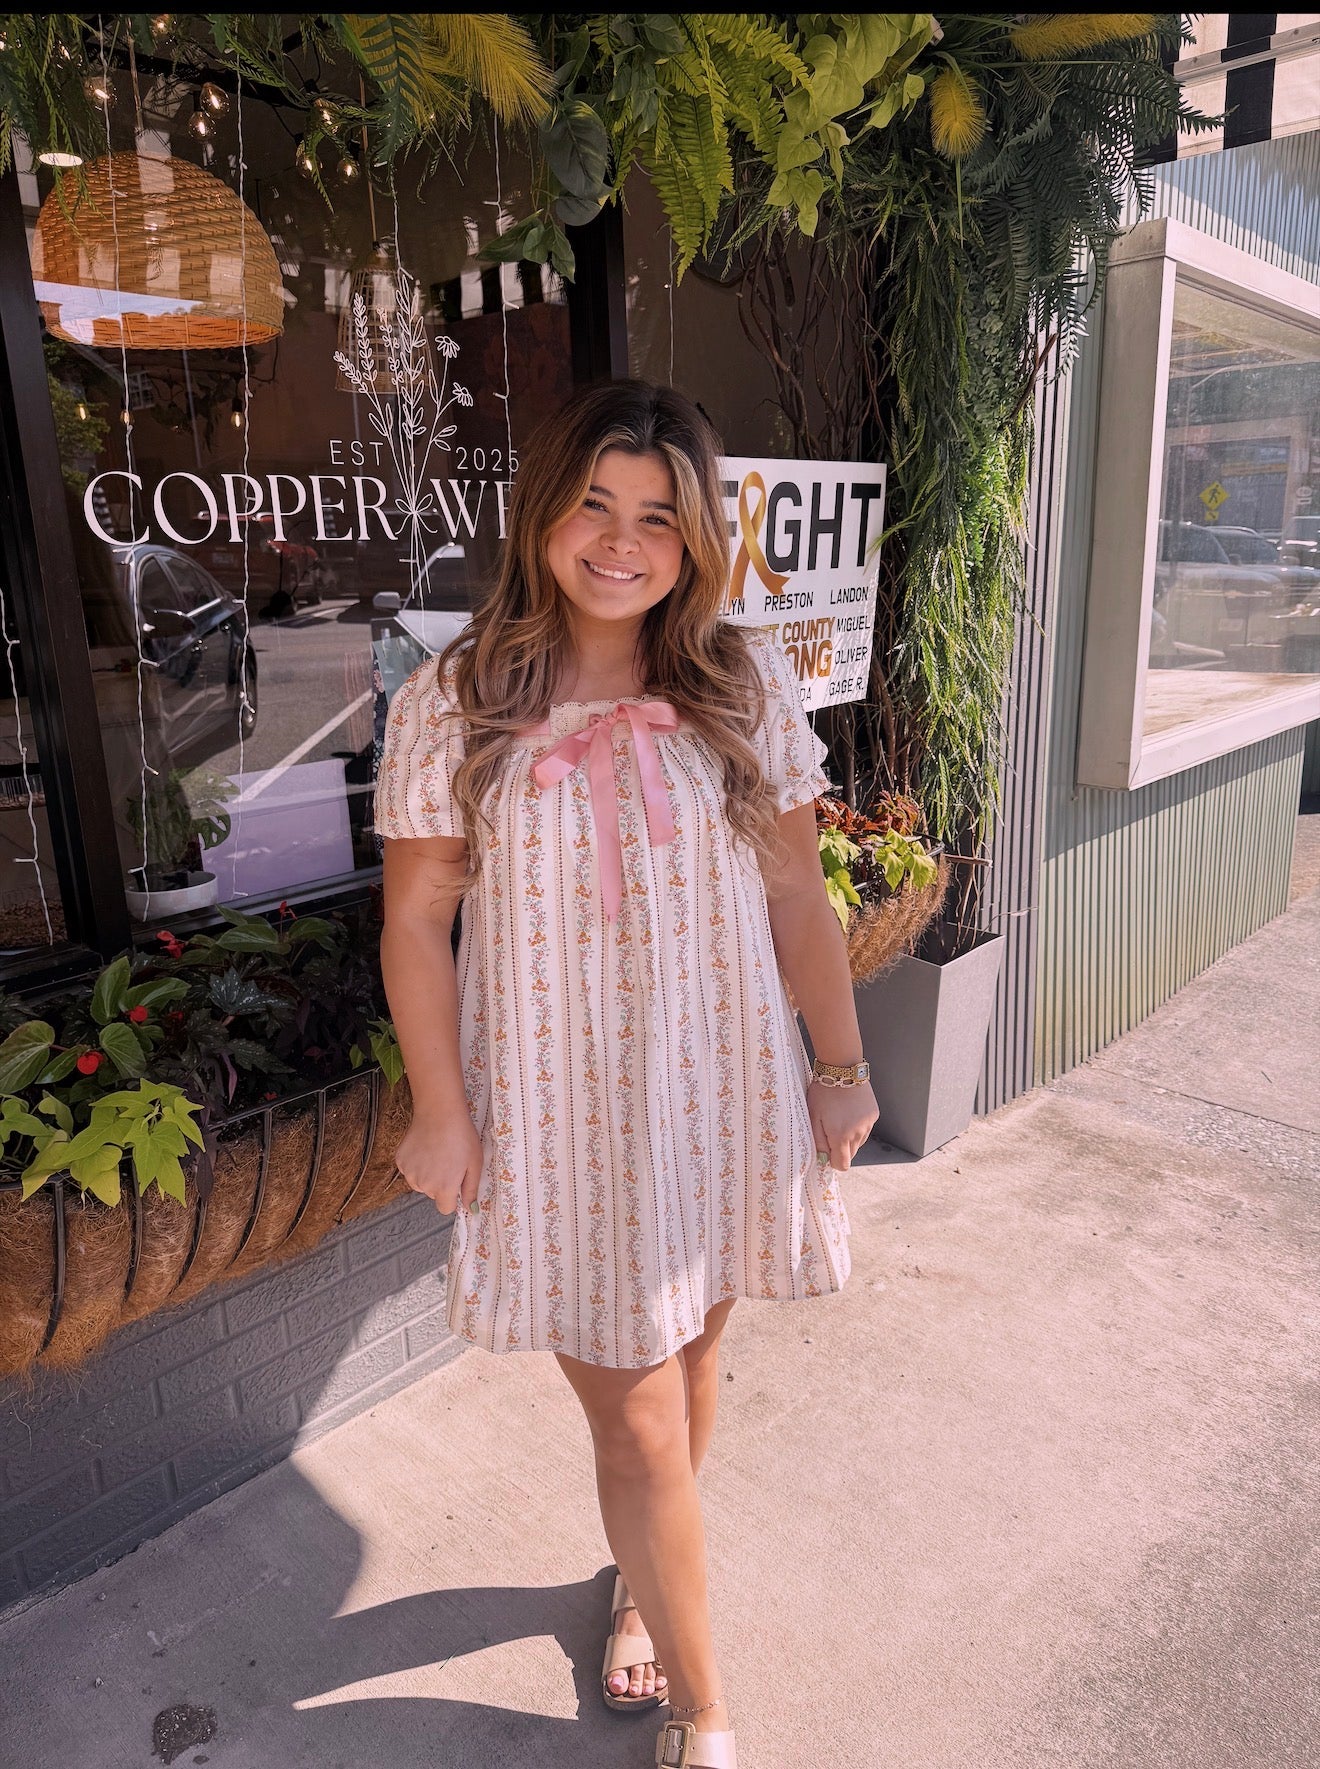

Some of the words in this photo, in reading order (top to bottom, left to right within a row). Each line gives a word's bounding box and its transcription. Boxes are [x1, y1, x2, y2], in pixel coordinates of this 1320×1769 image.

[329, 440, 384, 466] EST
[455, 446, 519, 472] 2025
[83, 470, 397, 545] COPPER
[764, 591, 814, 612] PRESTON
[830, 586, 869, 605] LANDON
[782, 617, 836, 644] COUNTY
[836, 615, 871, 632] MIGUEL
[835, 646, 868, 665] OLIVER
[828, 678, 854, 696] GAGE
